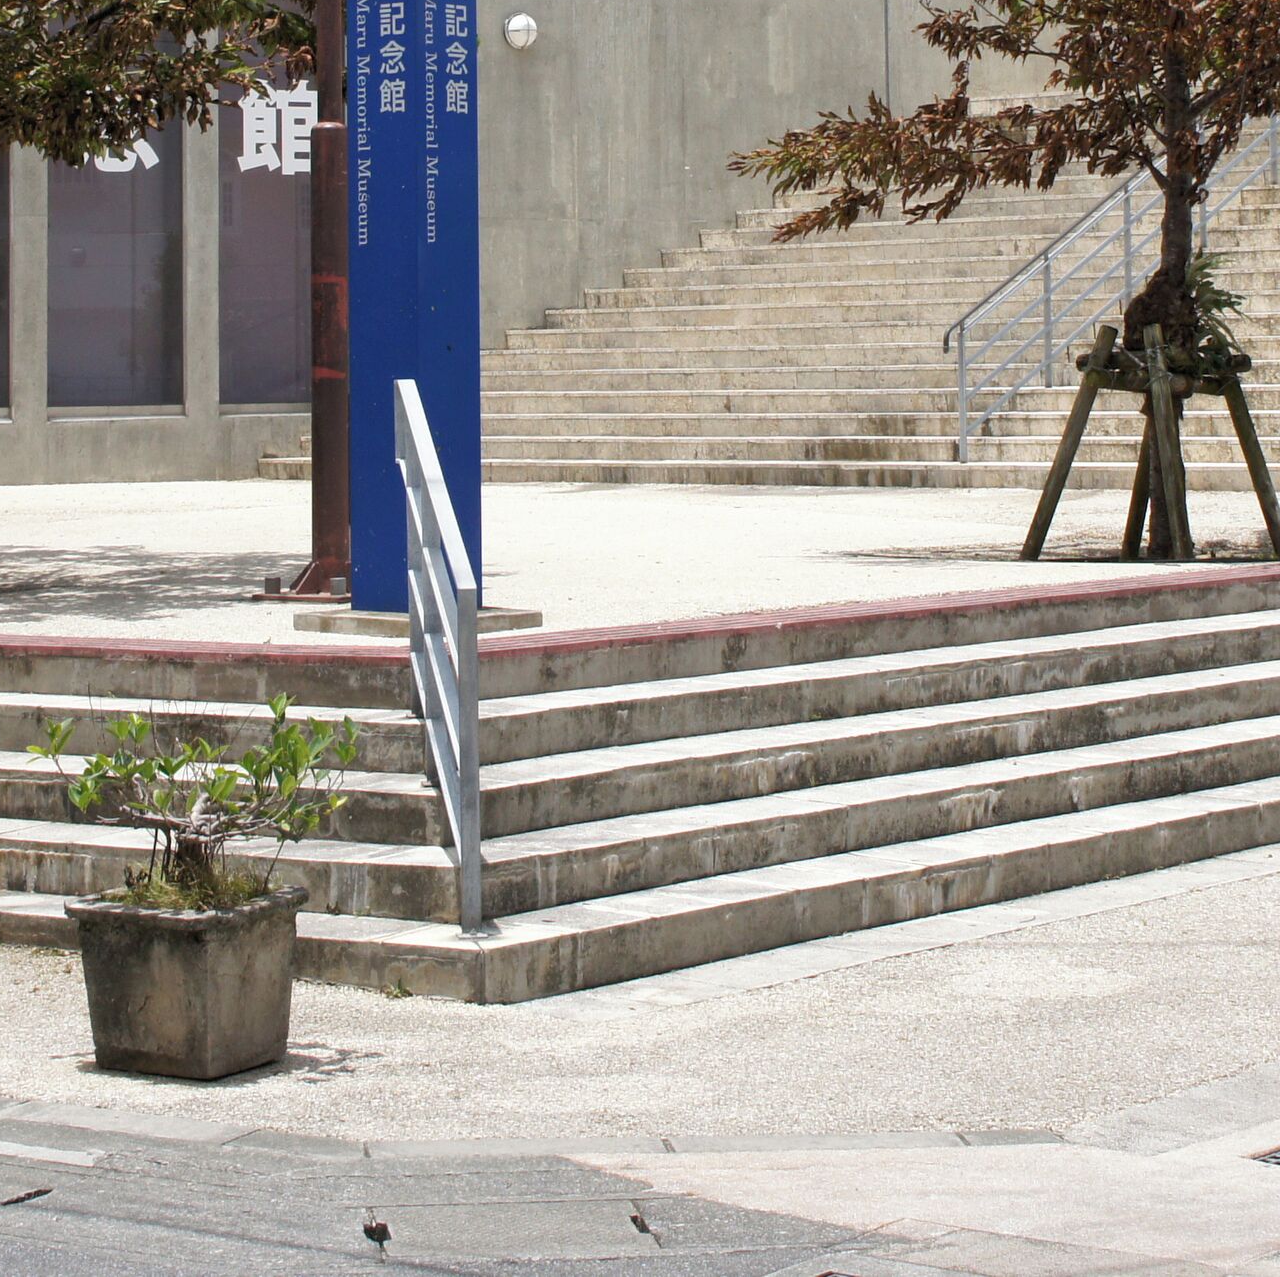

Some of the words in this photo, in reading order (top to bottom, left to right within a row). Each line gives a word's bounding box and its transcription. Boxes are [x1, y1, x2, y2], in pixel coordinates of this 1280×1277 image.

[356, 55, 371, 152] Memorial
[425, 52, 438, 149] Memorial
[357, 158, 371, 246] Museum
[426, 155, 438, 243] Museum
